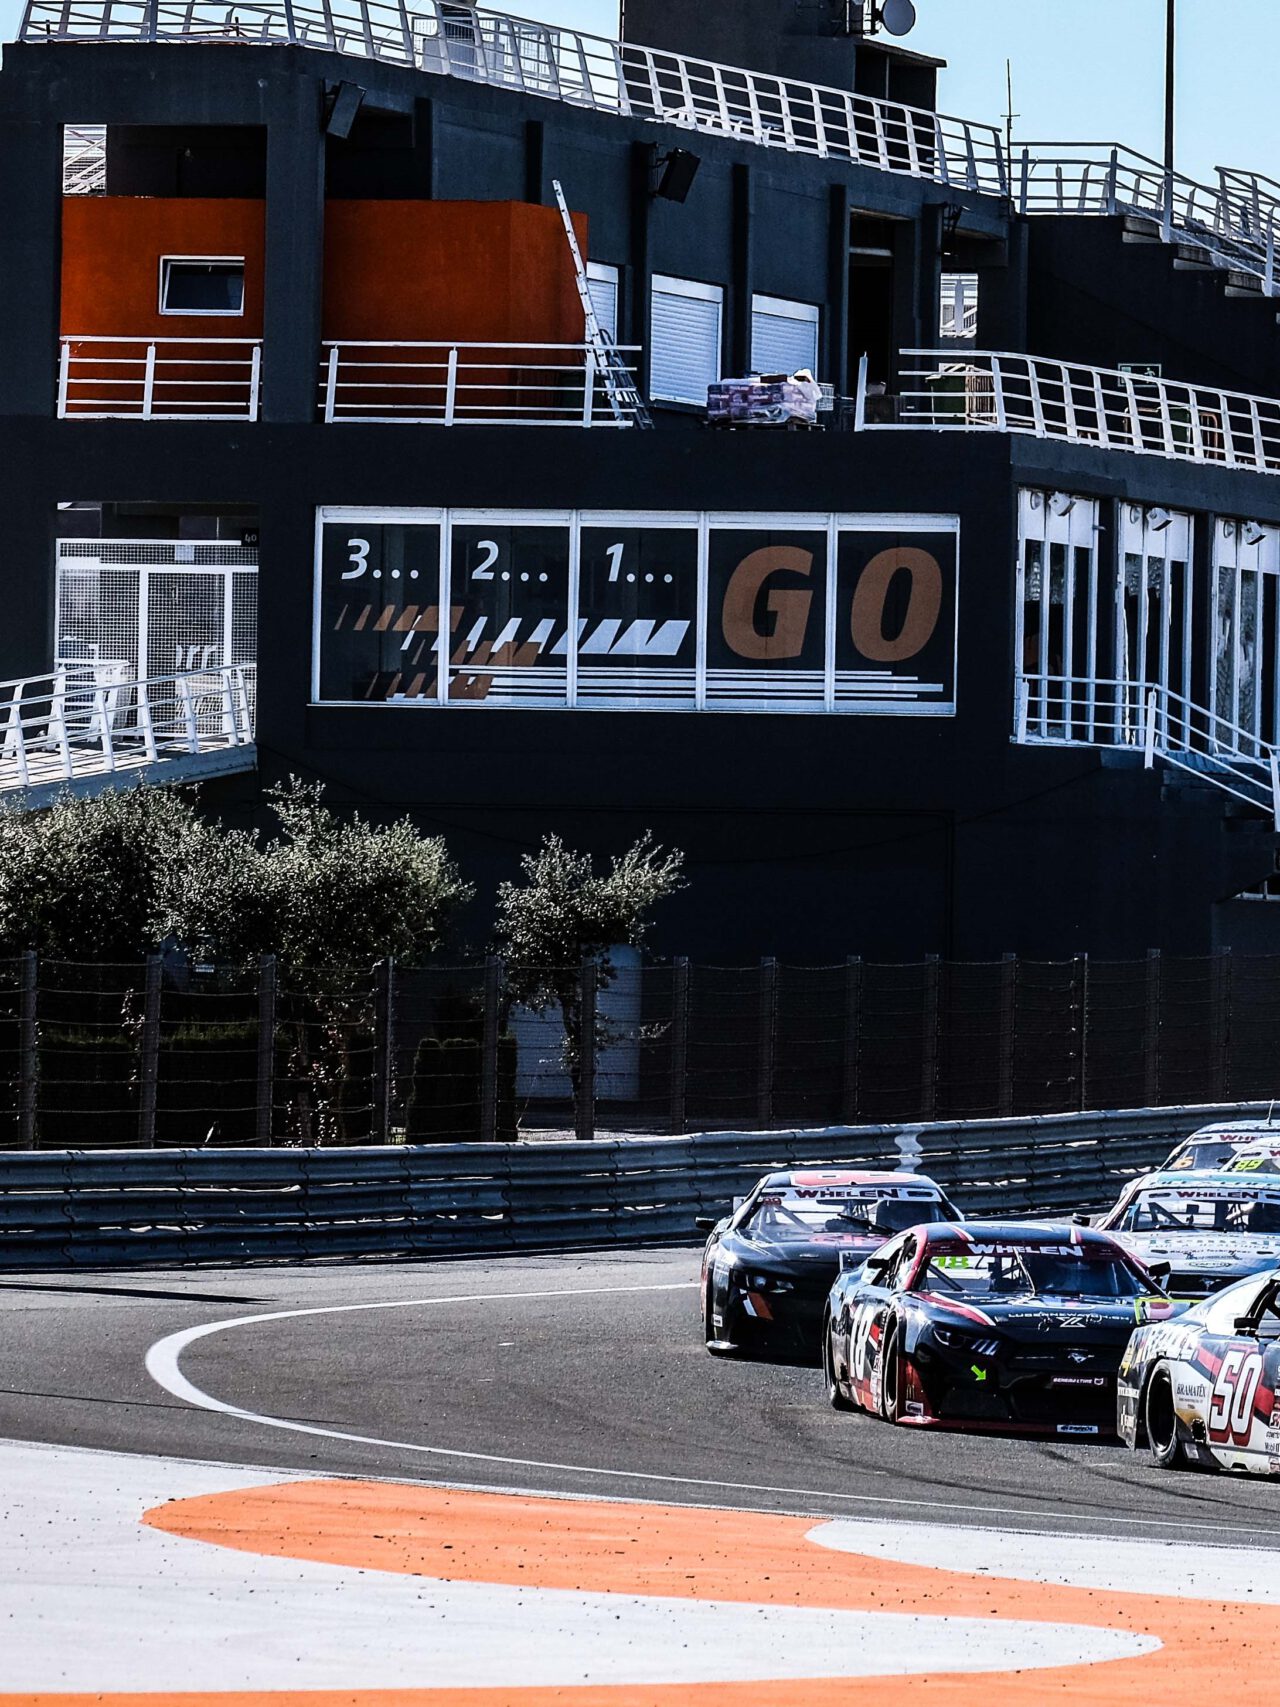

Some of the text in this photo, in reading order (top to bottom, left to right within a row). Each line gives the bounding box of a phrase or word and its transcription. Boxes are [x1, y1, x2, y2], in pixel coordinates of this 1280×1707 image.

[342, 538, 942, 662] 3... 2... 1... GO
[795, 1189, 899, 1198] WHELEN
[1177, 1191, 1259, 1199] WHELEN
[967, 1244, 1083, 1256] WHELEN
[931, 1257, 969, 1269] 18
[851, 1303, 876, 1381] 18
[1209, 1351, 1263, 1436] 50
